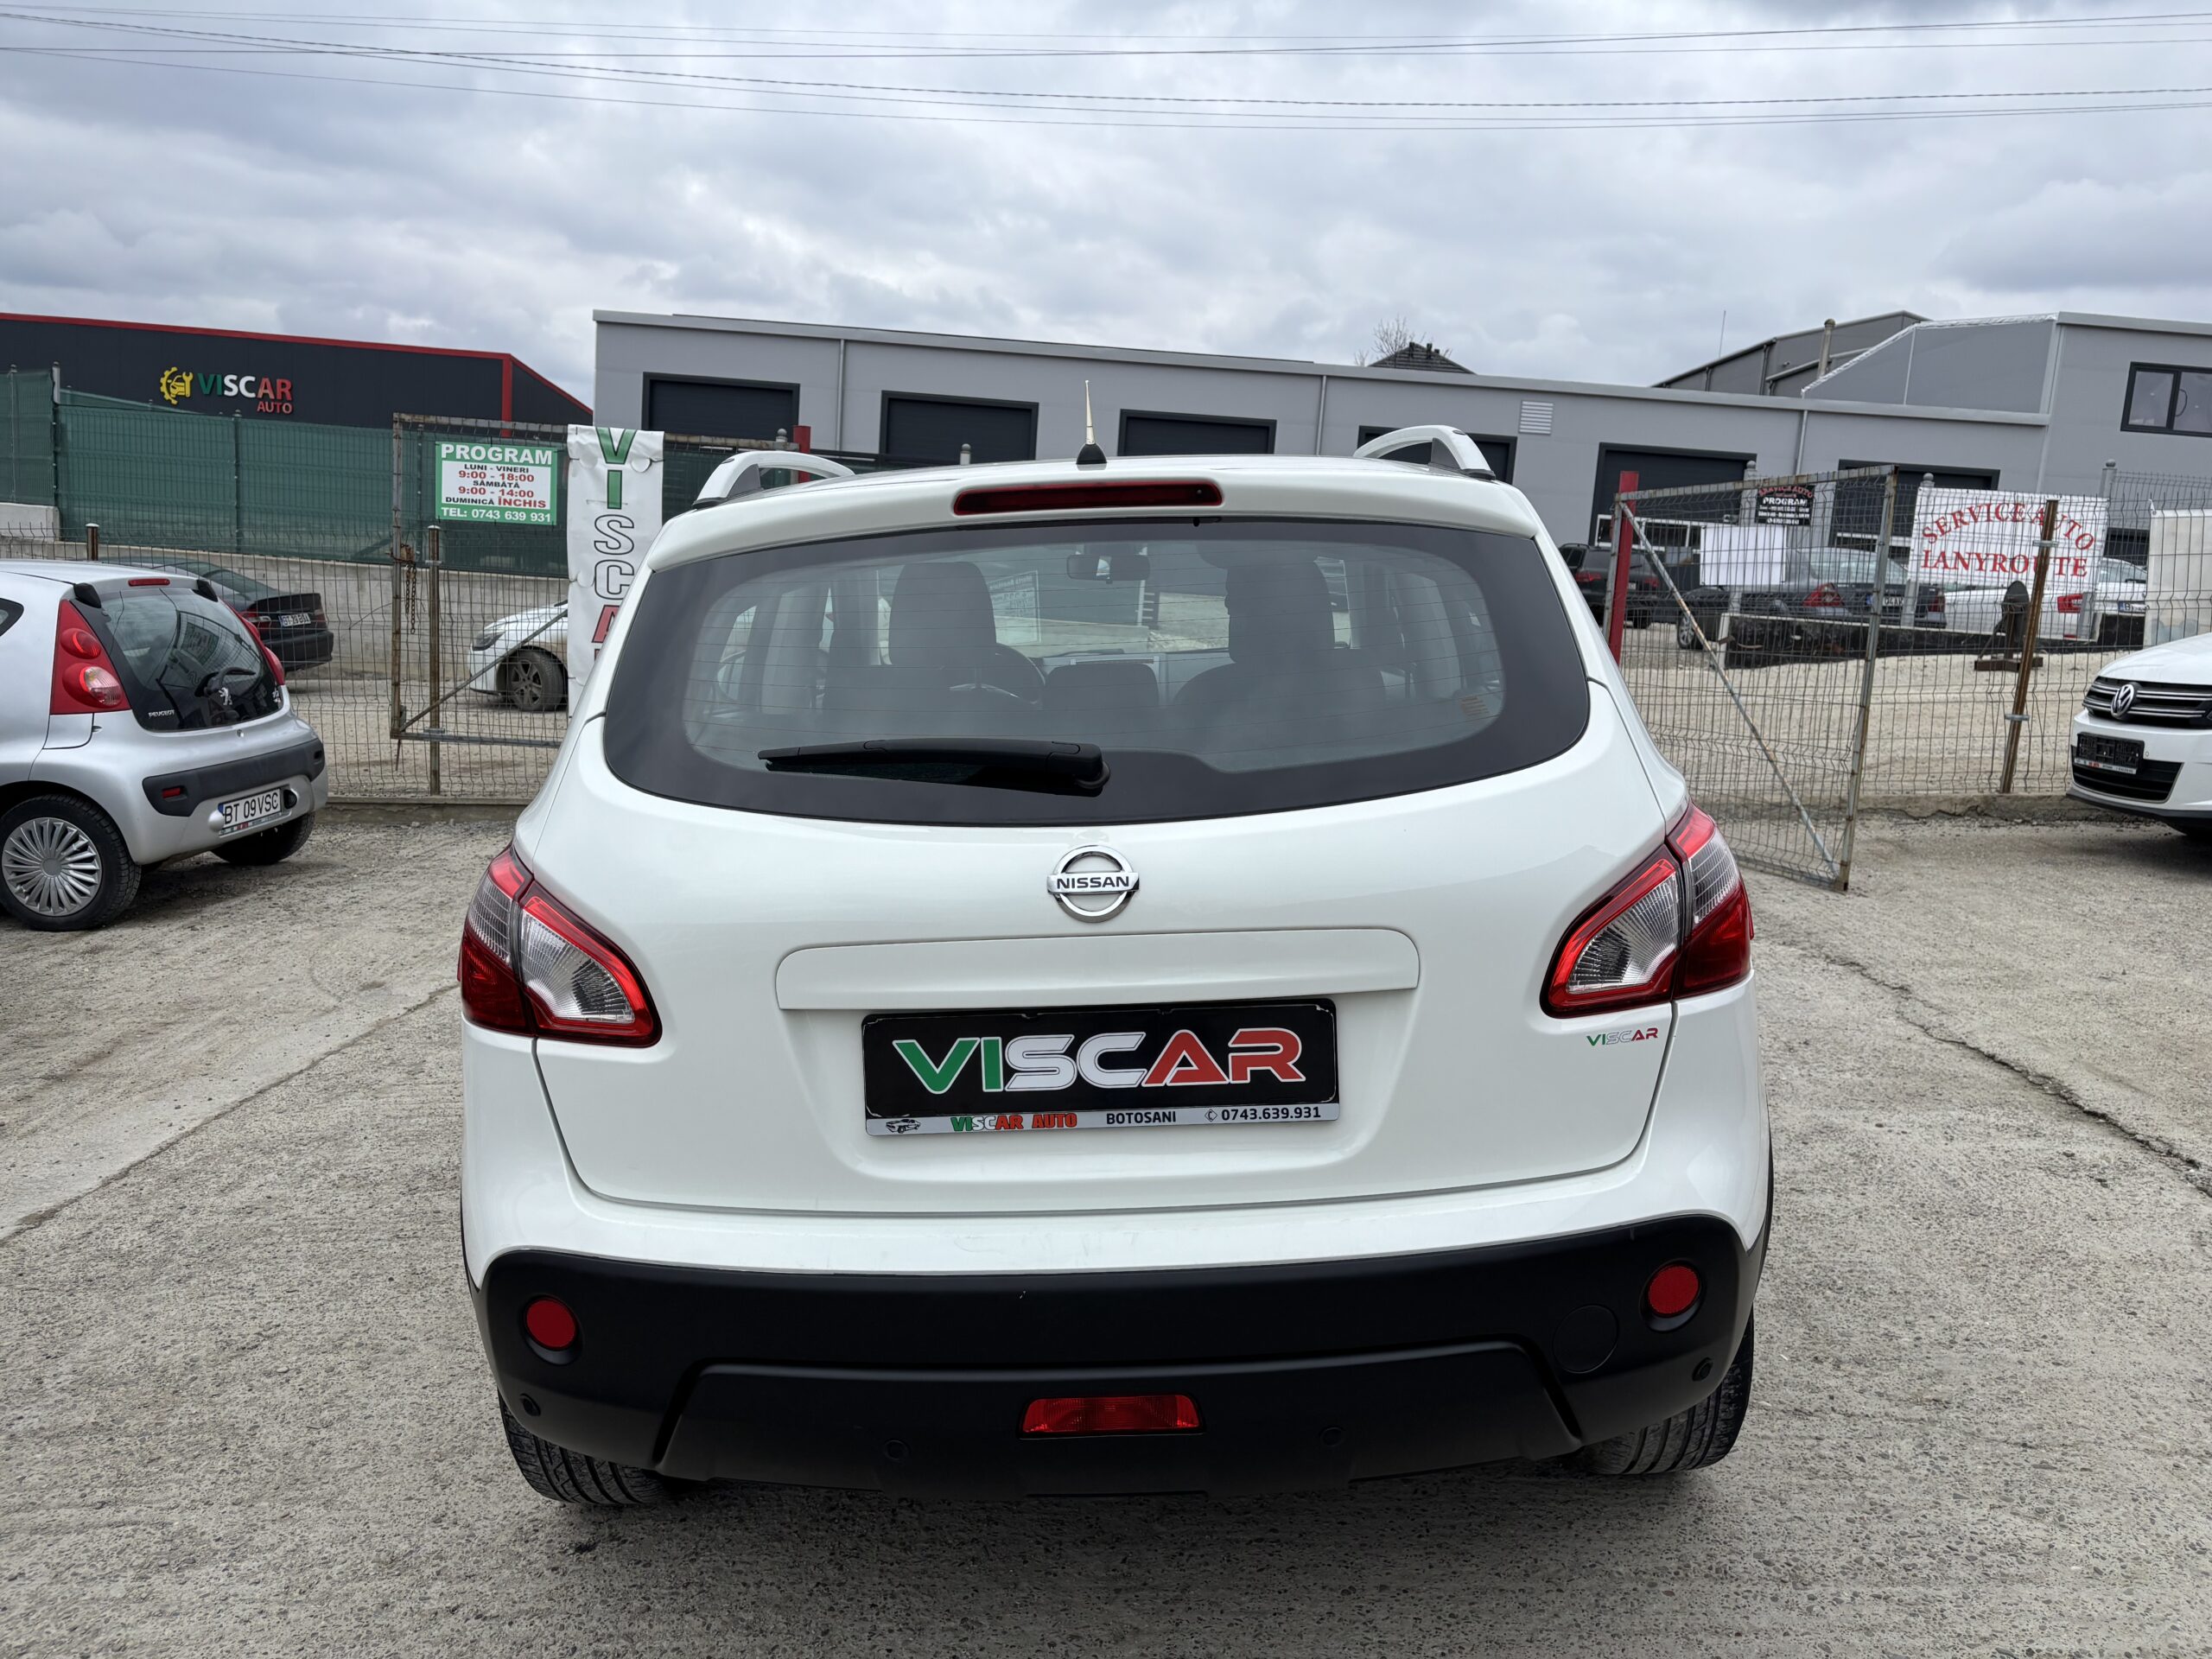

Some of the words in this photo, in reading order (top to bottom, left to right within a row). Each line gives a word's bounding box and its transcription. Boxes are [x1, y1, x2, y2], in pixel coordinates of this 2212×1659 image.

[197, 372, 293, 400] VISCAR
[257, 401, 293, 414] AUTO
[441, 443, 552, 465] PROGRAM
[458, 470, 486, 480] 9:00
[499, 473, 534, 482] 18:00
[496, 465, 530, 474] VINERI
[458, 486, 486, 495] 9:00
[499, 489, 534, 498] 14:00
[441, 506, 467, 518] TEL:
[471, 508, 500, 519] 0743
[505, 511, 526, 521] 639
[530, 512, 551, 522] 931
[1922, 502, 2025, 544] SERVICE
[591, 426, 635, 661] VISCA
[225, 803, 240, 825] BT
[243, 798, 257, 819] 09
[257, 792, 278, 815] VSC
[1057, 876, 1129, 890] NISSAN
[1586, 1027, 1659, 1046] VISCAR
[892, 1027, 1306, 1095] VISCAR
[950, 1115, 1024, 1132] VISCAR
[1032, 1113, 1077, 1129] AUTO
[1106, 1110, 1177, 1125] BOTOSANI
[1221, 1106, 1321, 1122] 0743.639.931
